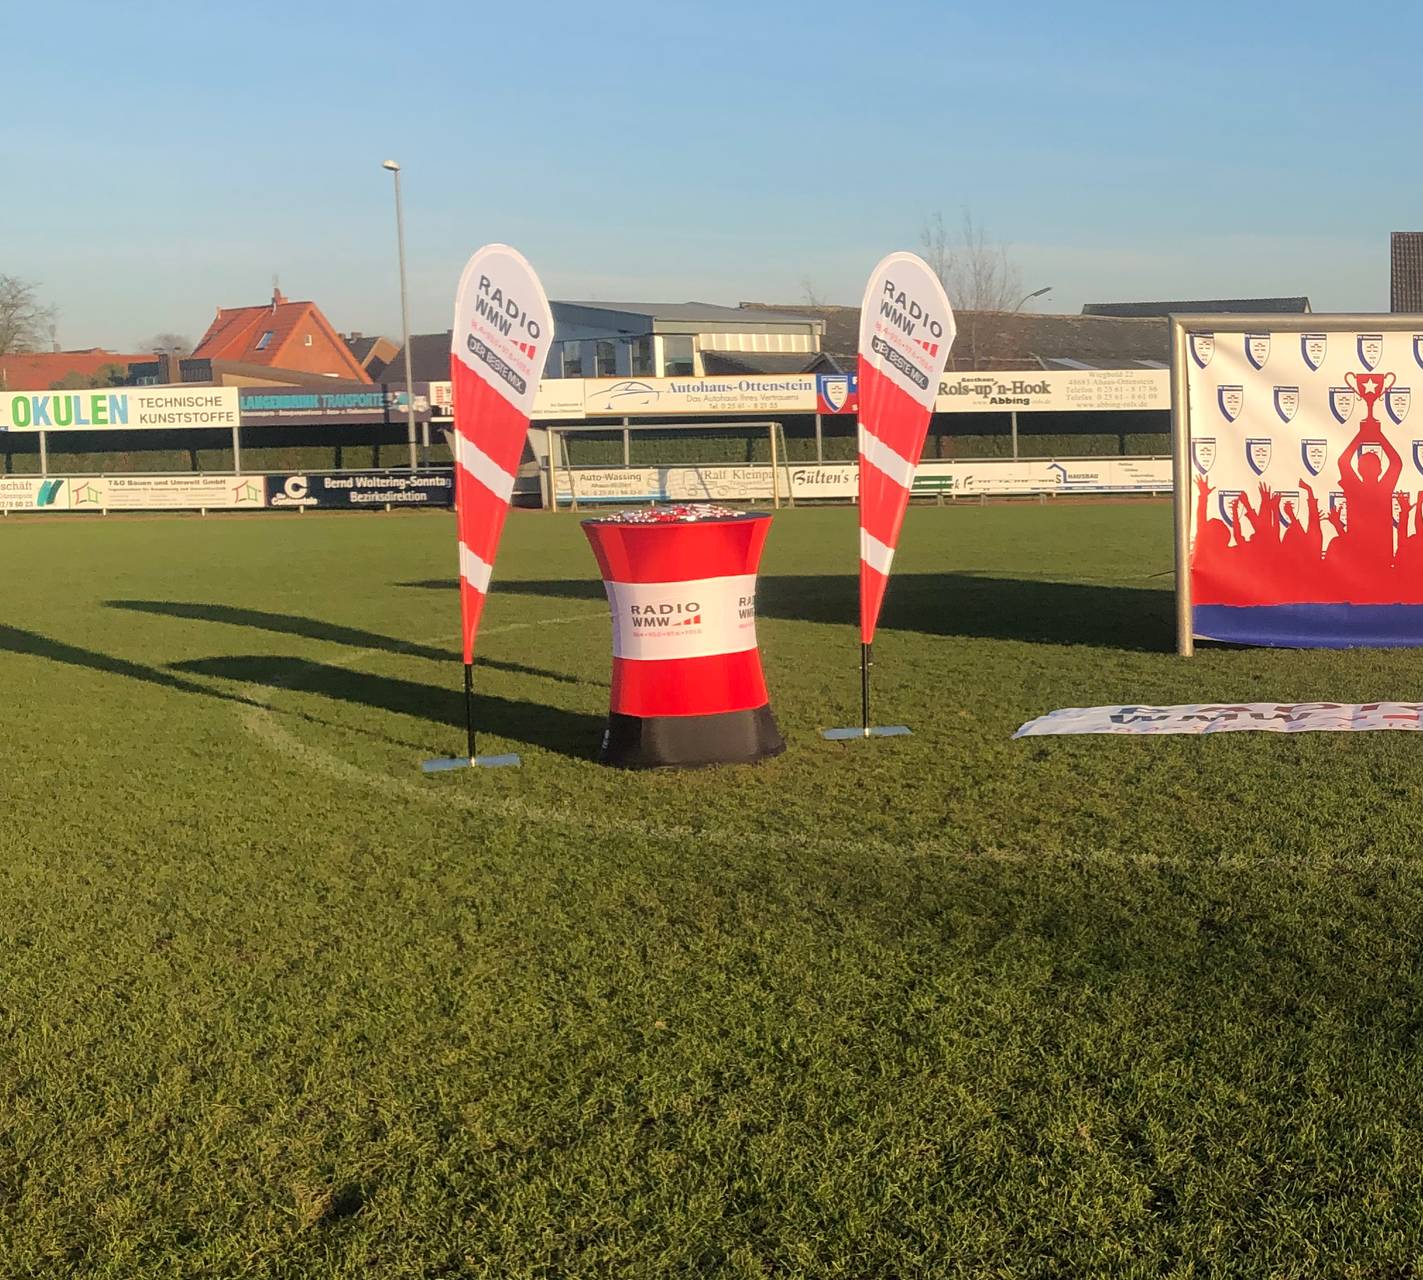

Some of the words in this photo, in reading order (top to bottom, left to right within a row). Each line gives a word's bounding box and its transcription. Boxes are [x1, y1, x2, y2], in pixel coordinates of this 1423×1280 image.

[479, 275, 541, 339] RADIO
[883, 280, 942, 338] RADIO
[475, 295, 512, 336] WMW
[880, 299, 915, 336] WMW
[667, 378, 812, 393] Autohaus-Ottenstein
[703, 394, 738, 402] Autohaus
[990, 397, 1030, 405] Abbing
[12, 394, 129, 427] OKULEN
[139, 396, 223, 408] TECHNISCHE
[140, 411, 234, 424] KUNSTSTOFFE
[580, 472, 641, 482] Auto-Wassing
[704, 470, 727, 480] Ralf
[792, 468, 849, 486] Bülten's
[324, 477, 353, 488] Bernd
[355, 476, 451, 489] Woltering-Sonntag
[350, 491, 427, 503] Bezirksdirektion
[631, 602, 700, 615] RADIO
[633, 616, 670, 627] WMW
